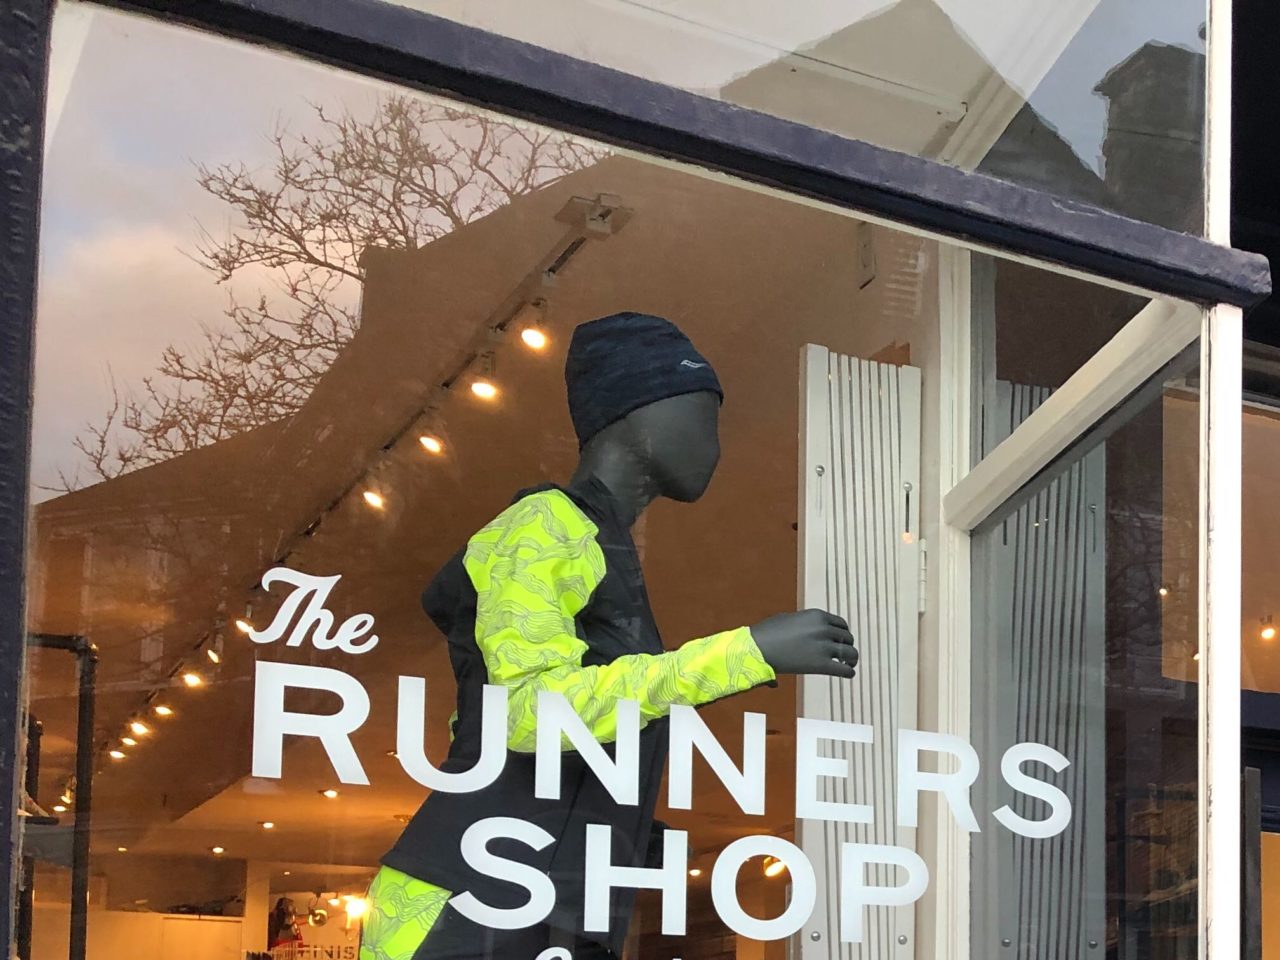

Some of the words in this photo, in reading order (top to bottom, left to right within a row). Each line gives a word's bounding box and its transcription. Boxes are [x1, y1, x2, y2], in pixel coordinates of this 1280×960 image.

[248, 568, 379, 654] The
[251, 661, 1072, 838] RUNNERS
[450, 816, 929, 943] SHOP
